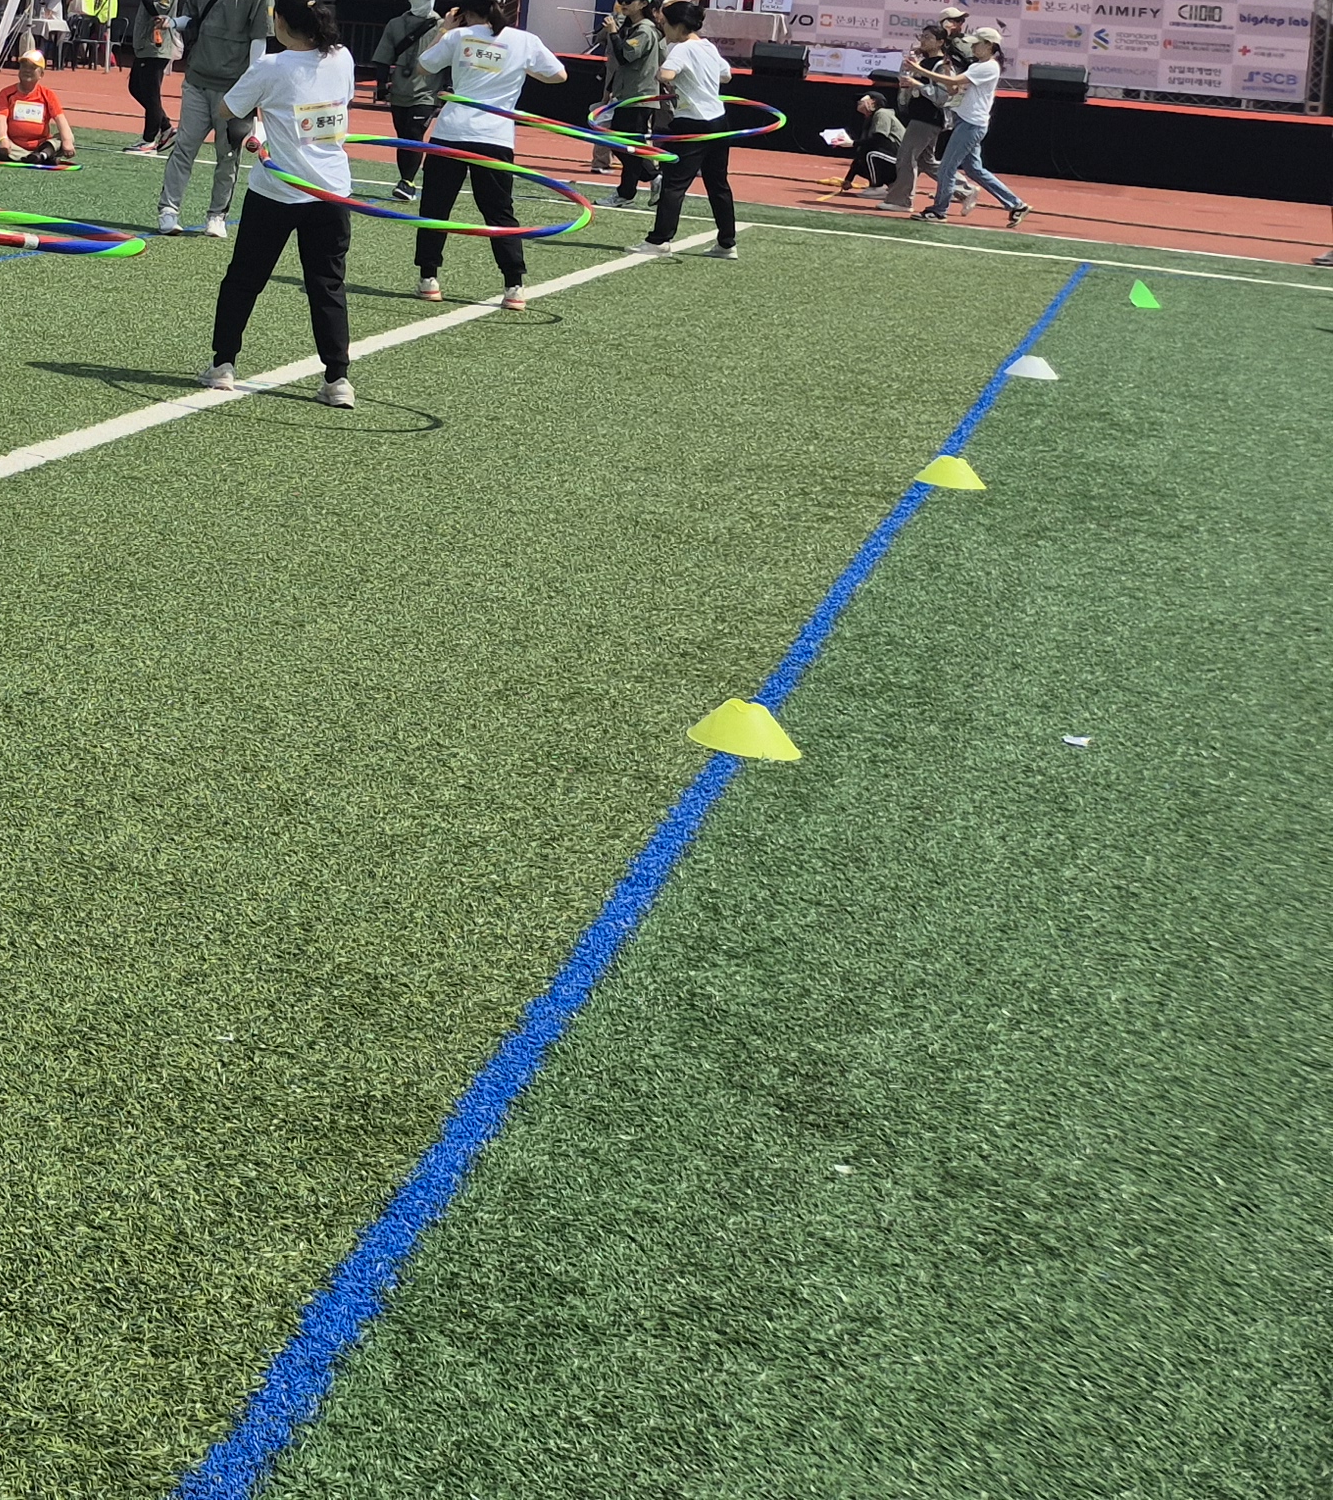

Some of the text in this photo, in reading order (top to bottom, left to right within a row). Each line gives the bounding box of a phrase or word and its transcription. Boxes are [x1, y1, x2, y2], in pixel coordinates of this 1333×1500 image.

[1043, 1, 1092, 14] 본도시락
[1095, 5, 1161, 18] AIMIFY
[1239, 13, 1285, 27] bigstep
[1288, 16, 1309, 27] lab
[1168, 65, 1221, 77] 삼일회계법인
[1168, 76, 1221, 88] 삼일미래재단
[1262, 72, 1297, 85] SCB
[316, 113, 345, 129] 동작구
